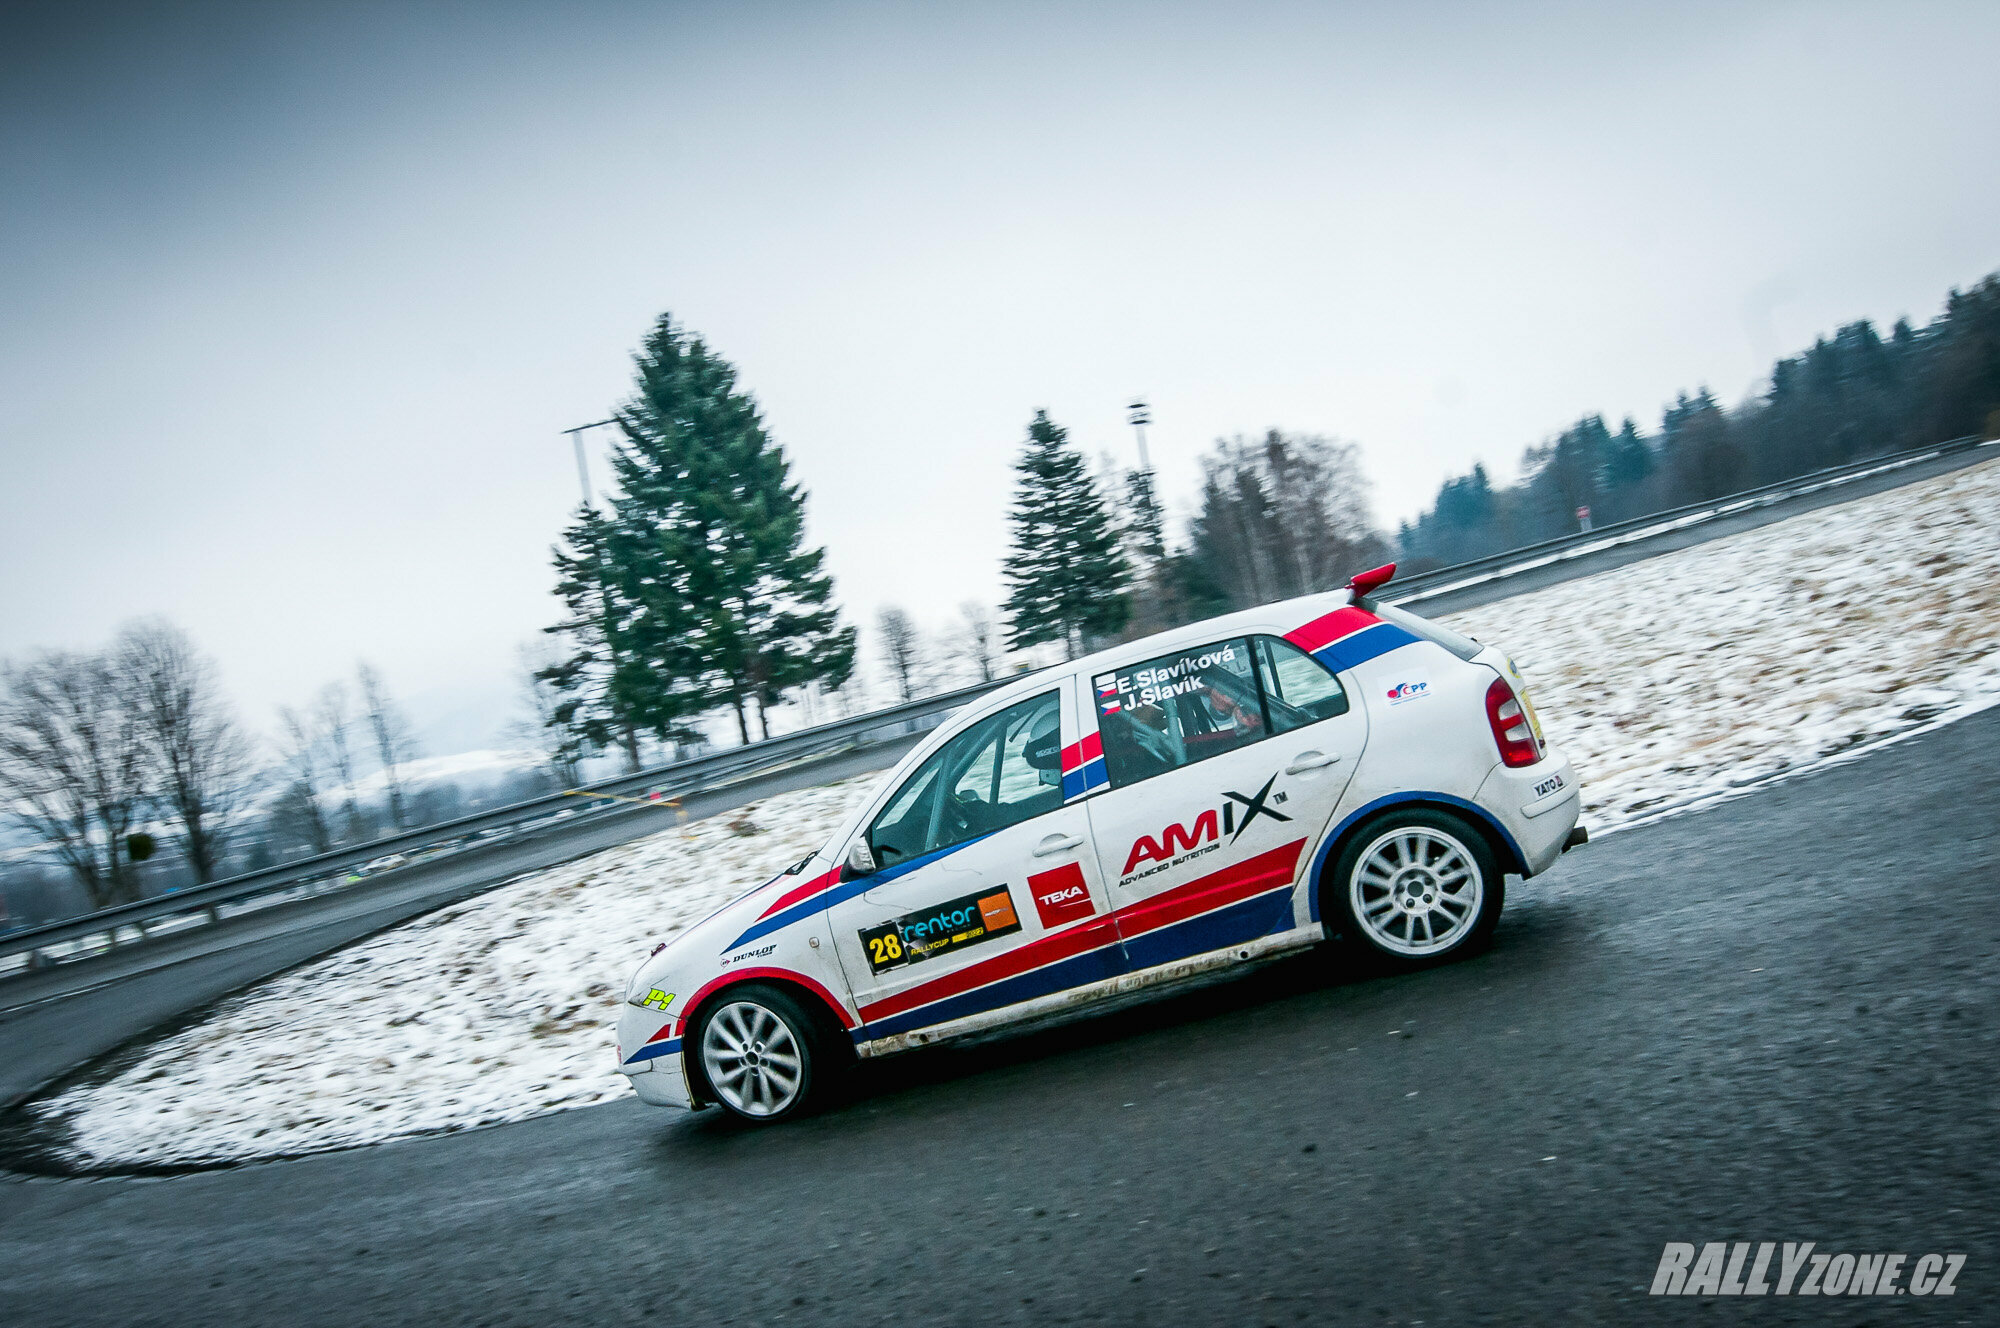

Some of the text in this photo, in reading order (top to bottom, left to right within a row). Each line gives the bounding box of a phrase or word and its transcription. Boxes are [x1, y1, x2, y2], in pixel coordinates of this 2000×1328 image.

[1117, 645, 1236, 694] E.Slavíková
[1123, 675, 1205, 711] J.Slavík
[1534, 777, 1557, 796] YATO
[1121, 770, 1294, 877] AMIX
[1118, 843, 1221, 888] ADVANCED NUTRITION
[1038, 885, 1084, 906] TEKA
[902, 906, 976, 942] rentor
[732, 944, 778, 963] DUNLOP
[869, 933, 902, 964] 28
[910, 938, 950, 956] RALLYCUP
